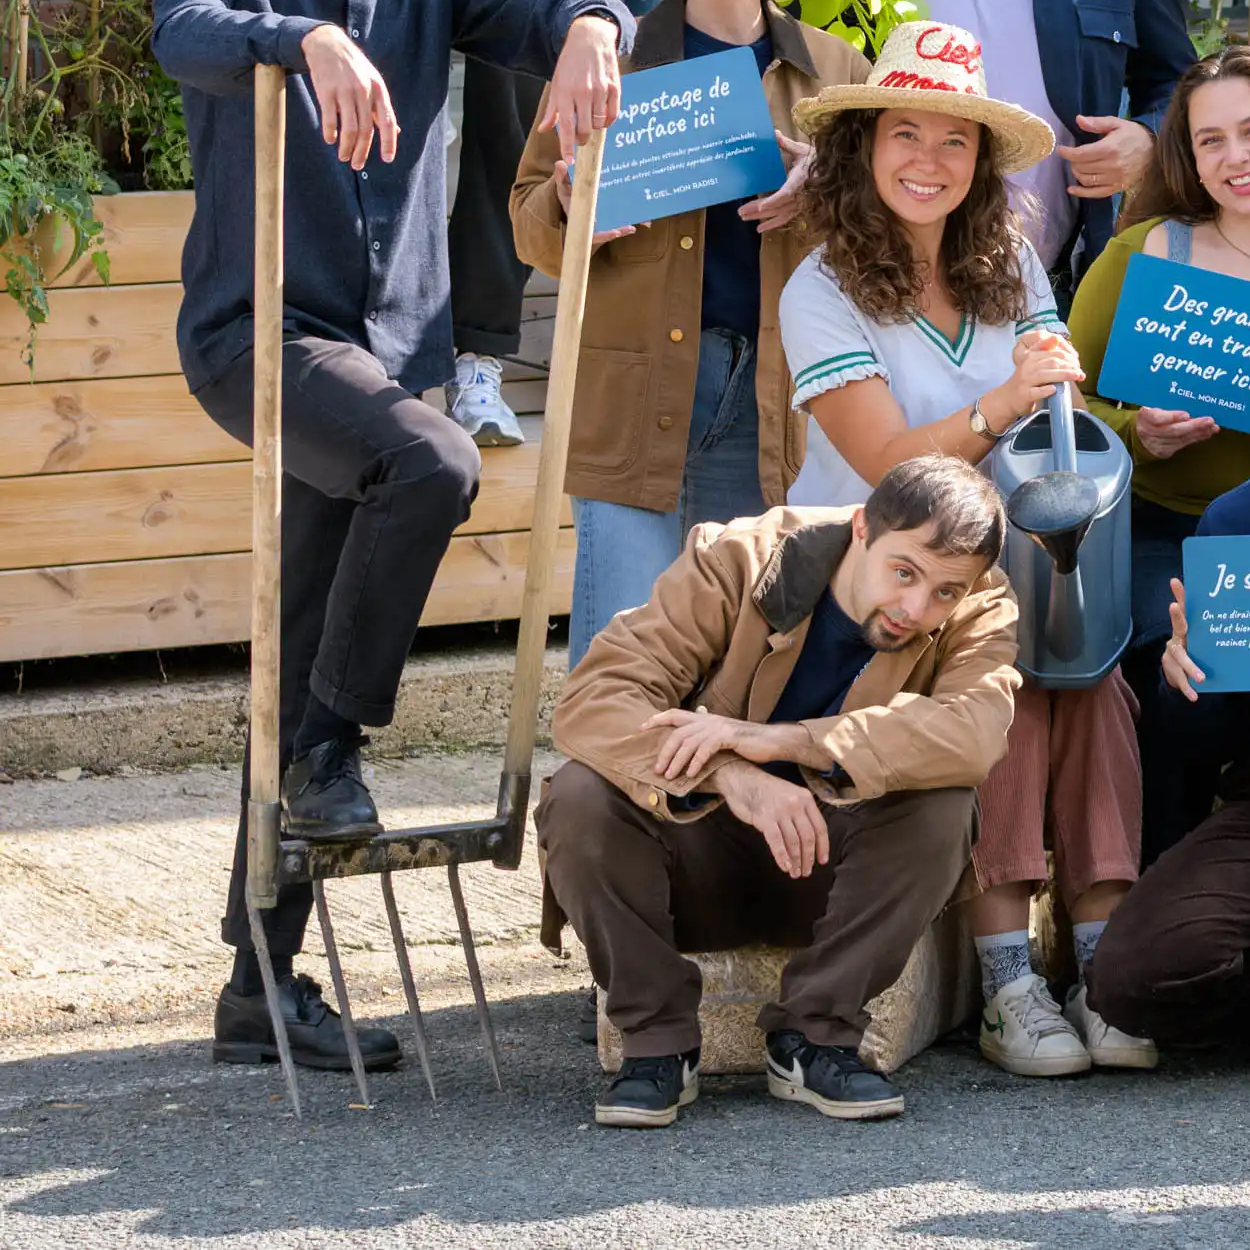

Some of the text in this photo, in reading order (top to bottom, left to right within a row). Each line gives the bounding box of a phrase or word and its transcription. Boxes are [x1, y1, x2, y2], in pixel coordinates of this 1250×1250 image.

[616, 75, 730, 125] mpostage de
[615, 106, 716, 148] surface ici
[672, 184, 692, 194] MON
[1163, 284, 1208, 317] Des
[1133, 316, 1186, 342] sont
[1188, 331, 1214, 348] en
[1150, 352, 1228, 382] germer
[1198, 393, 1218, 404] MON
[1208, 563, 1237, 598] Je
[1202, 610, 1214, 620] On
[1209, 623, 1222, 634] bel
[1224, 624, 1234, 634] et
[1216, 638, 1246, 646] racines
